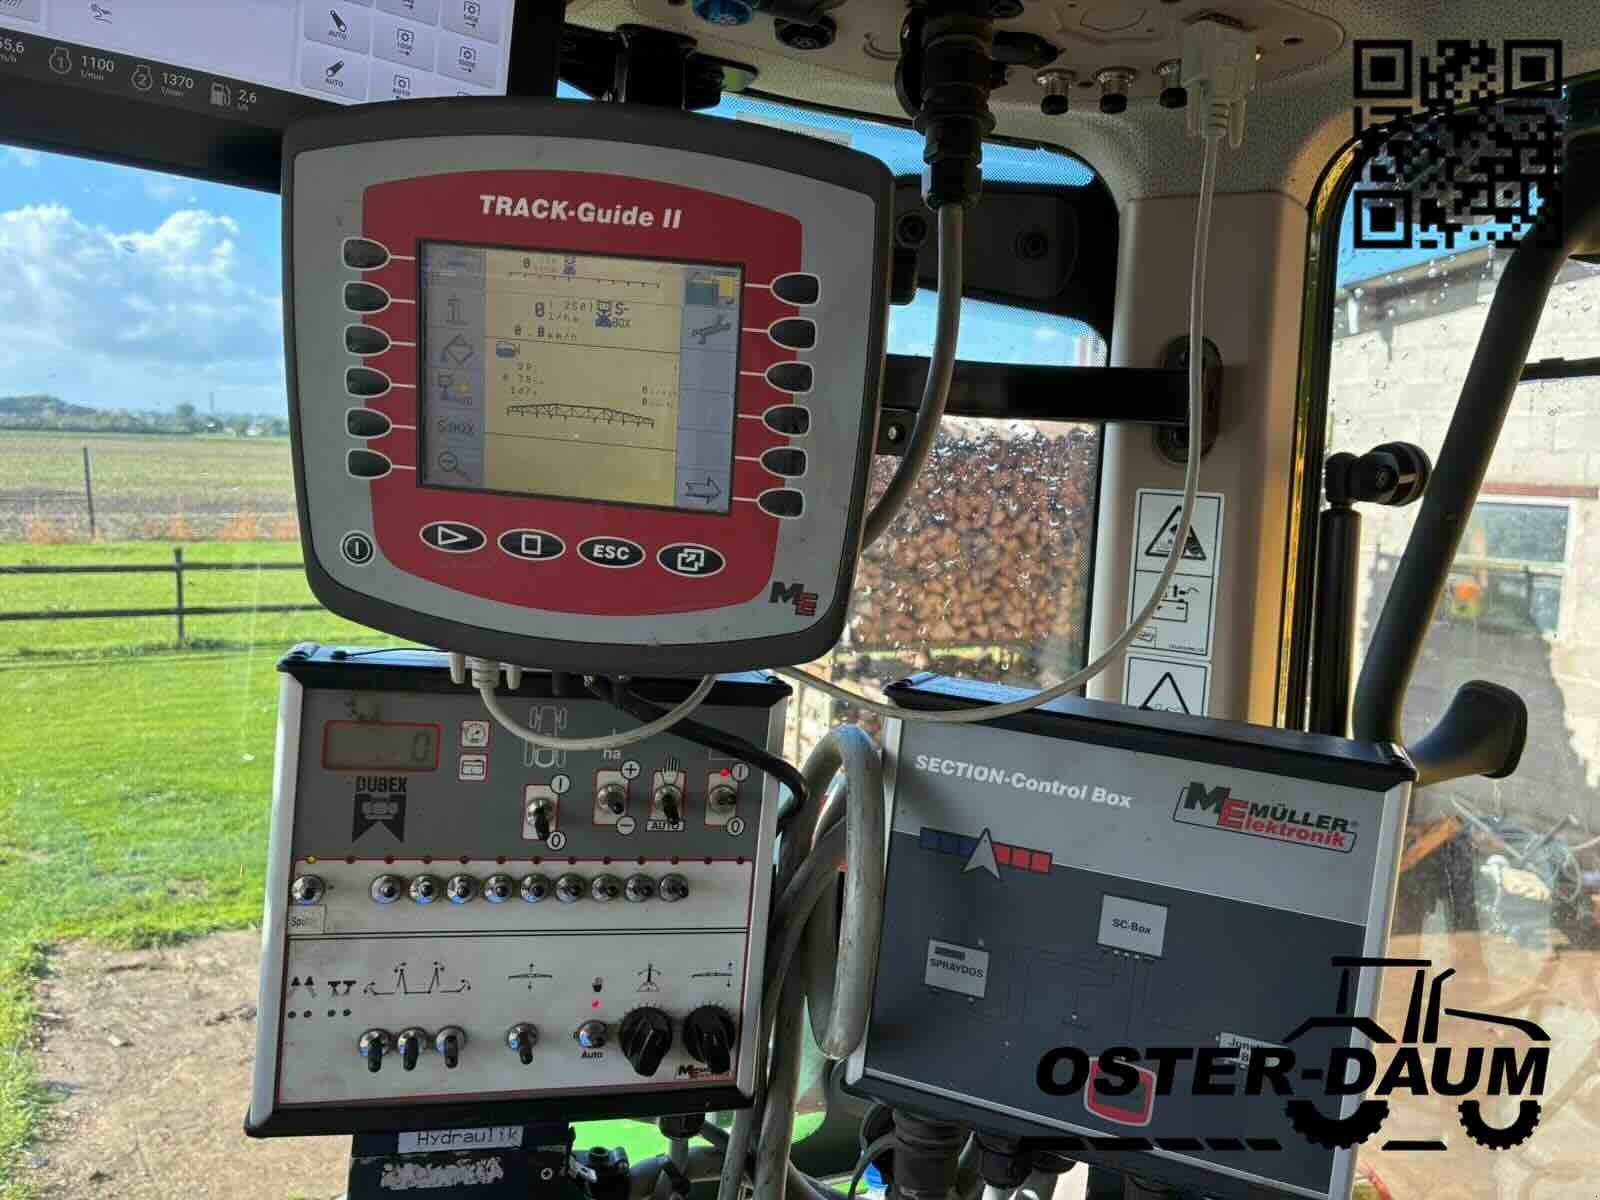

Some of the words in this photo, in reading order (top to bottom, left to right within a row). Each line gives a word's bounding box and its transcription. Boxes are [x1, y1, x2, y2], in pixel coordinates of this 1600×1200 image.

[81, 55, 114, 72] 1100
[161, 72, 194, 89] 1370
[239, 89, 257, 103] 2,6
[480, 195, 654, 227] TRACK-Guide
[662, 208, 682, 229] II
[592, 544, 631, 561] ESC
[768, 581, 818, 616] ME
[914, 754, 1088, 800] SECTION-Control
[1091, 786, 1133, 809] Box
[1111, 918, 1152, 935] SC-Box
[417, 1126, 518, 1147] Hydraulik
